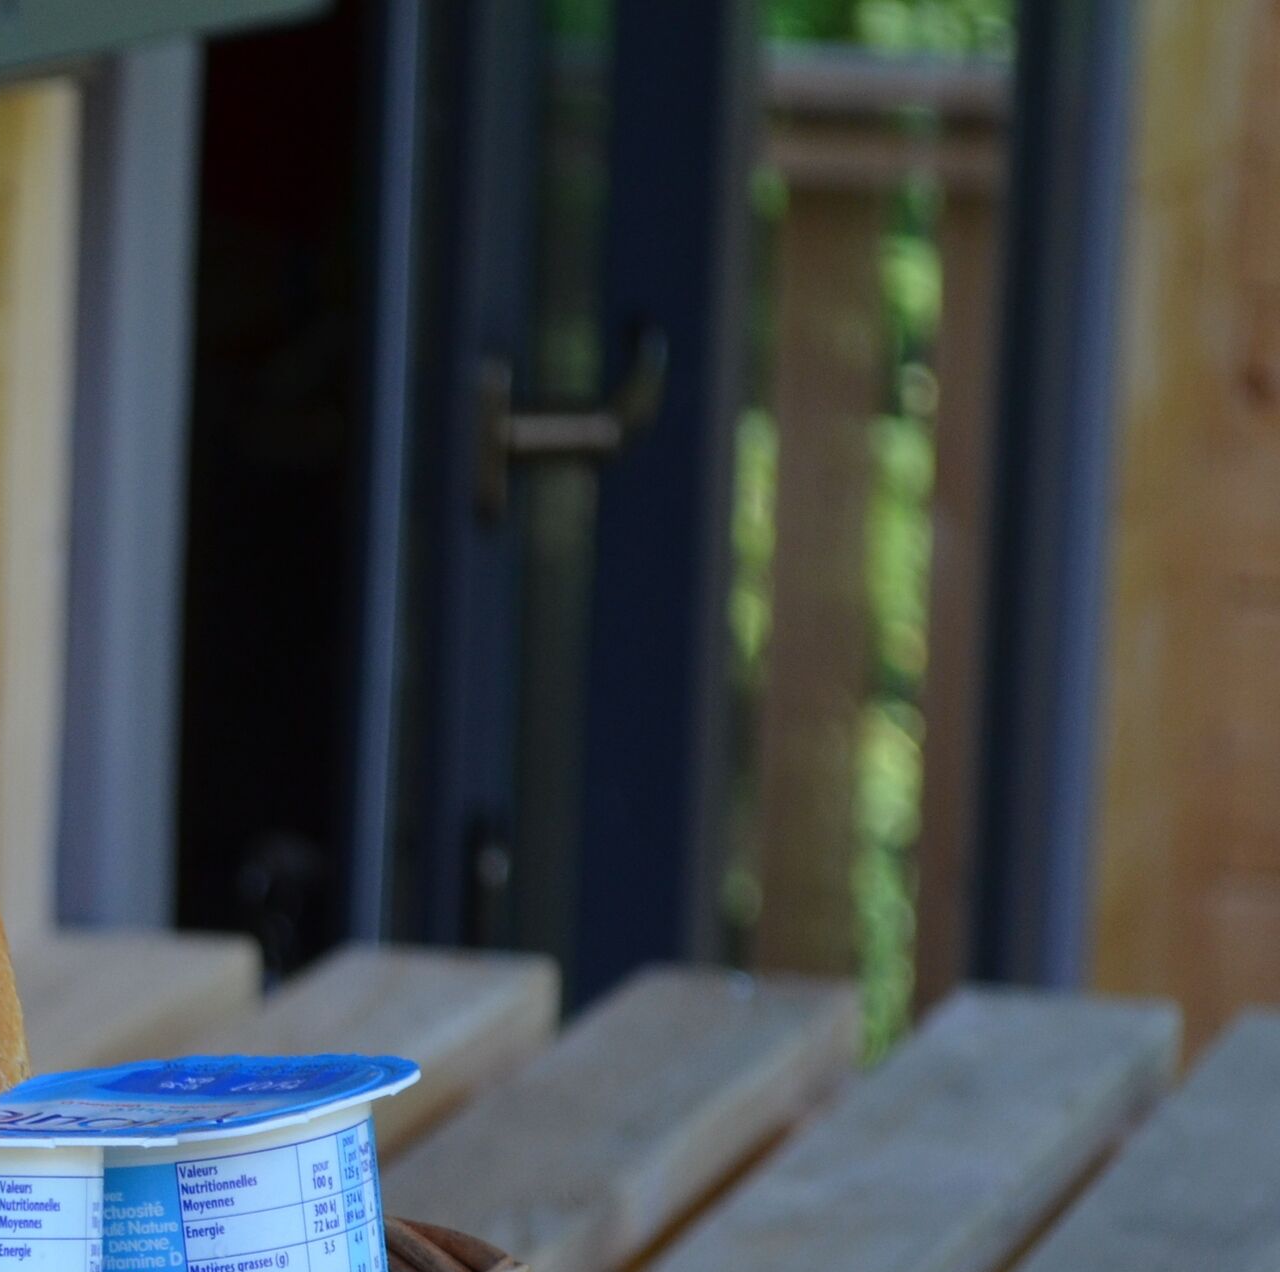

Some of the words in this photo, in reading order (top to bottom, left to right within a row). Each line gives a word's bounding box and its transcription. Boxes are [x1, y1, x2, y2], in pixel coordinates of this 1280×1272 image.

[179, 1165, 218, 1179] Valeurs
[313, 1160, 329, 1175] pour
[0, 1180, 32, 1194] Valeurs
[181, 1175, 257, 1196] Nutritionnelles
[313, 1175, 326, 1190] 100
[328, 1176, 333, 1190] g
[0, 1198, 61, 1212] Nutritionnelles
[183, 1197, 235, 1215] Moyennes
[314, 1202, 328, 1217] 300
[0, 1216, 43, 1233] Moyennes
[128, 1220, 179, 1235] Nature
[186, 1222, 225, 1240] Energie
[314, 1220, 324, 1234] 72
[326, 1214, 340, 1231] kcal
[170, 1250, 184, 1267] D
[275, 1251, 290, 1269] (g)
